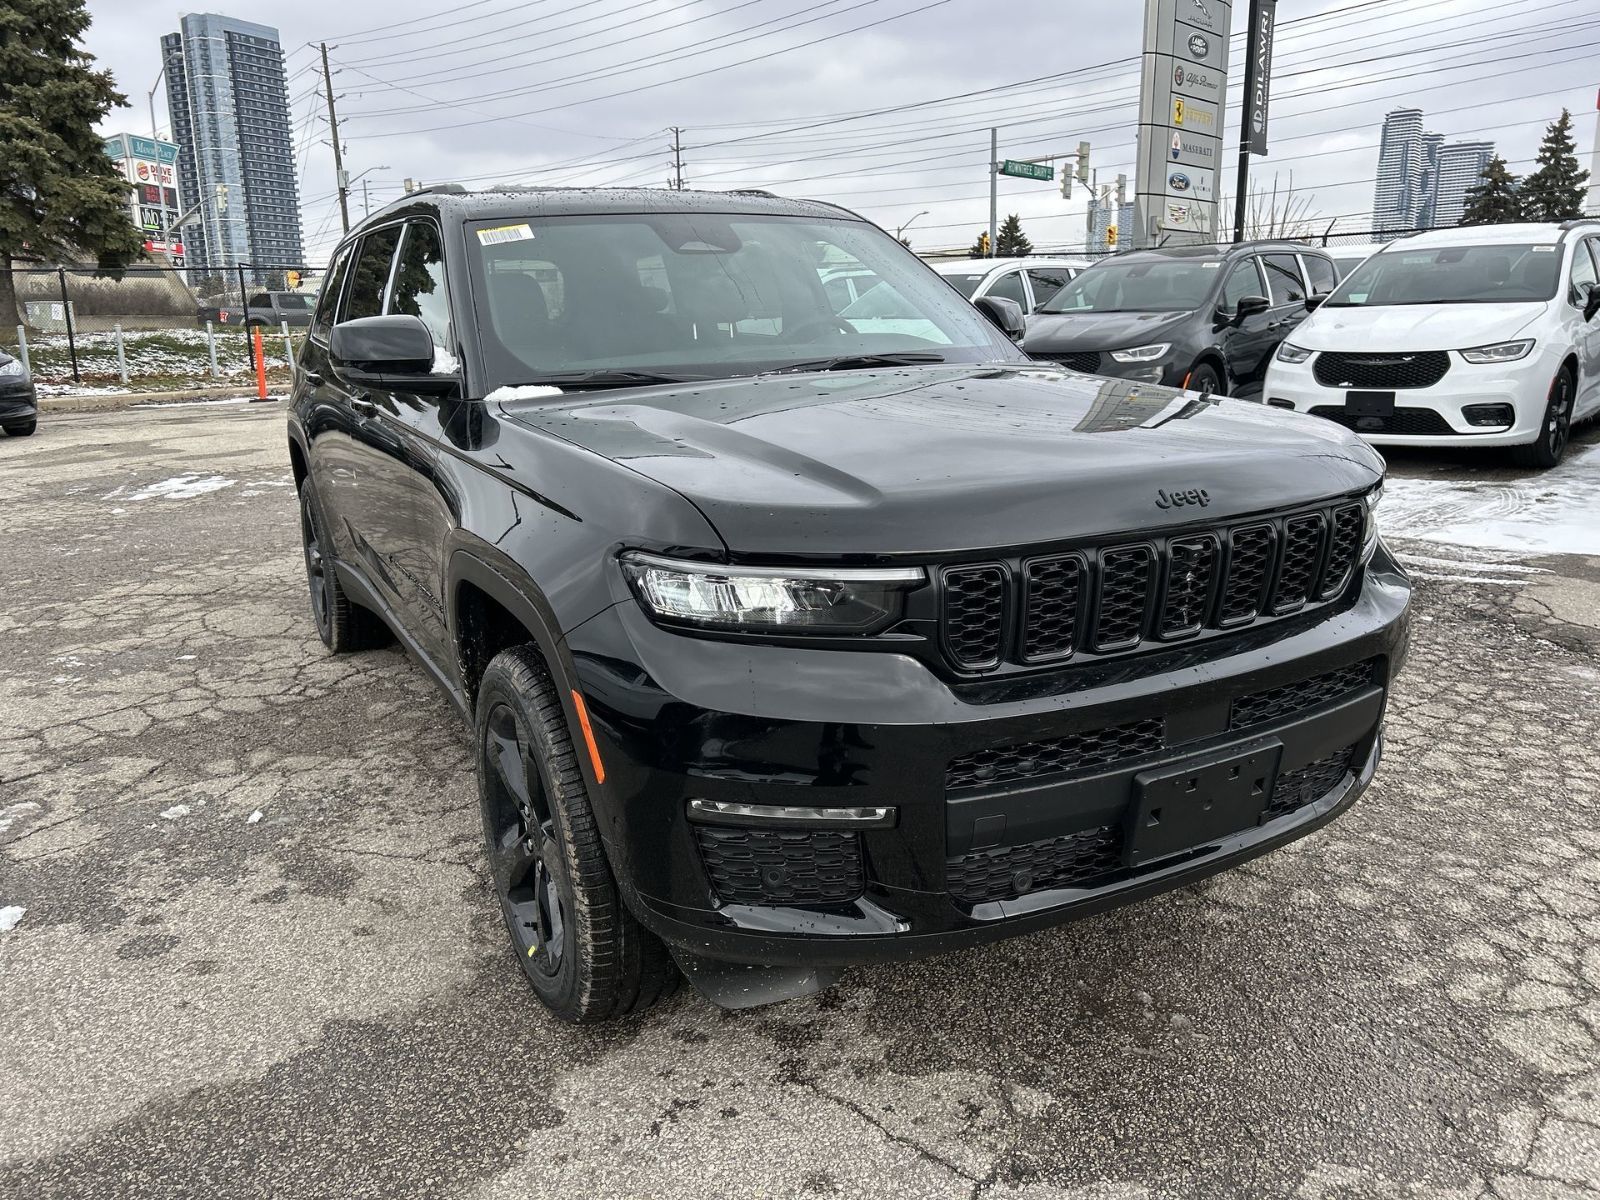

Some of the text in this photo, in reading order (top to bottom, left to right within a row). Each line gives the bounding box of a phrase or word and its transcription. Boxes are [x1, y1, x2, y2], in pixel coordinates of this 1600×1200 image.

[1256, 10, 1269, 106] DILAWRI
[1186, 72, 1200, 88] Alfa
[1182, 143, 1212, 157] MASERATI
[152, 173, 172, 185] TRU
[1155, 488, 1210, 509] Jeep
